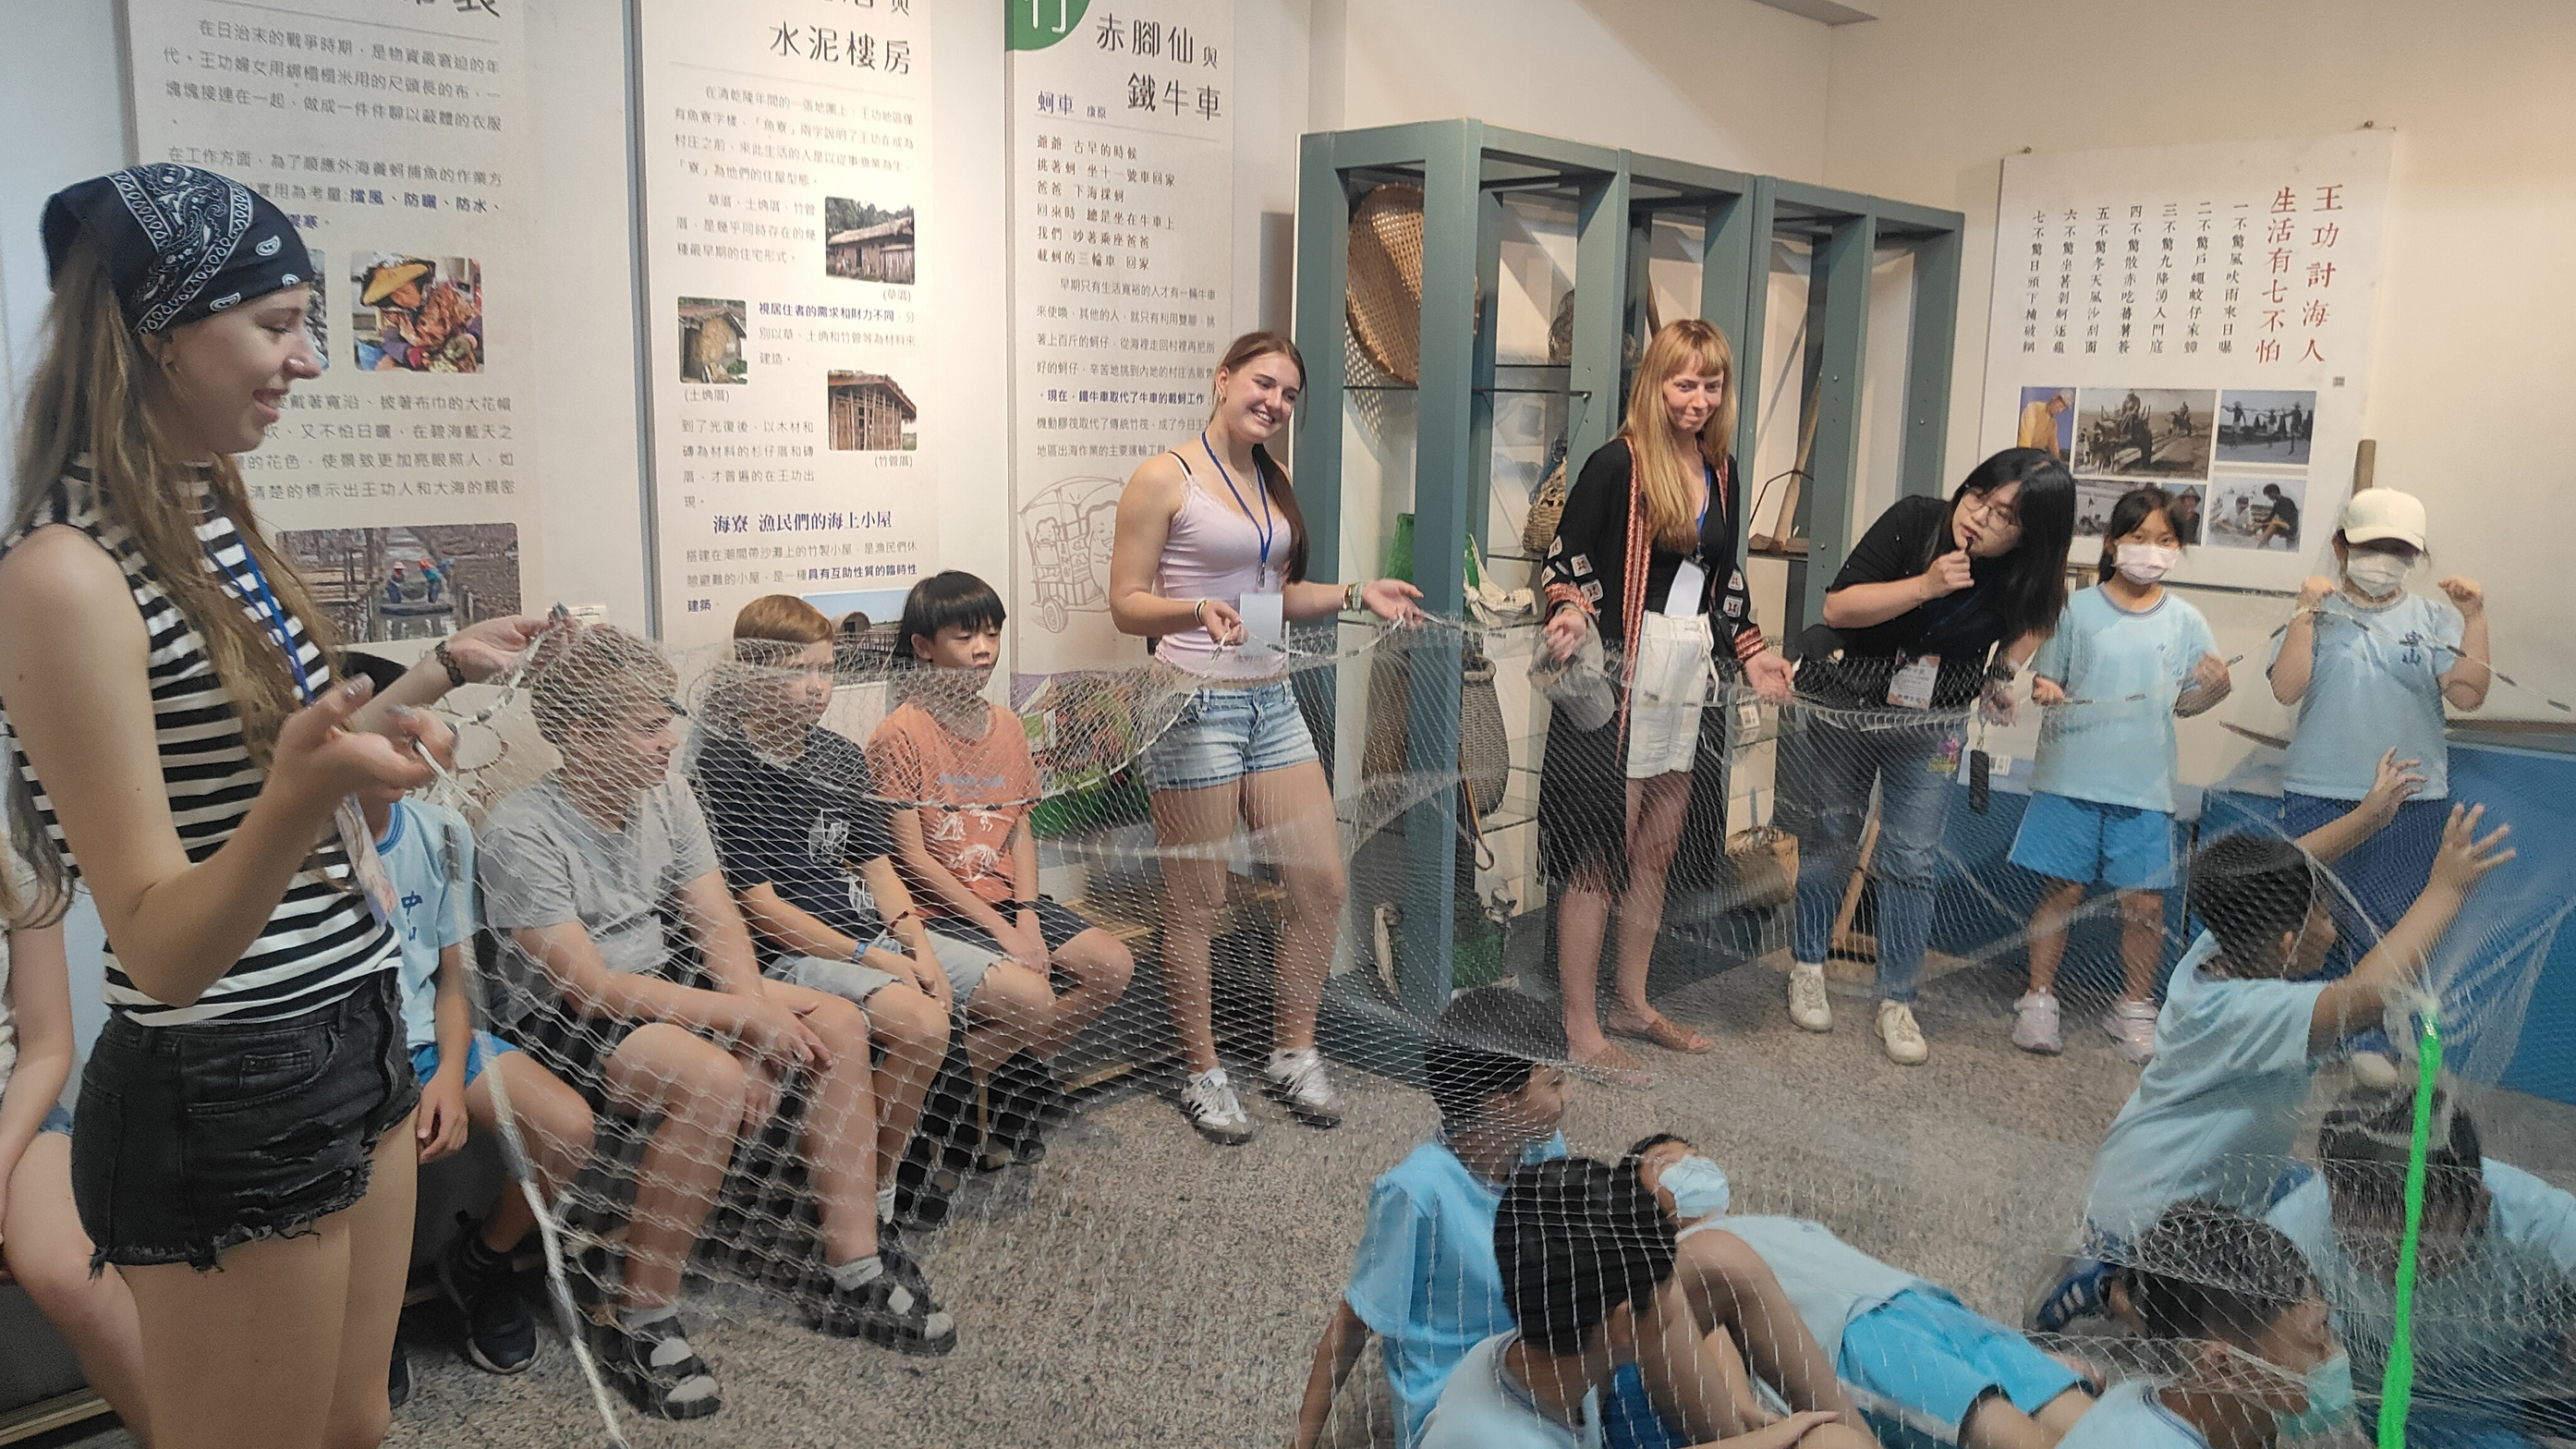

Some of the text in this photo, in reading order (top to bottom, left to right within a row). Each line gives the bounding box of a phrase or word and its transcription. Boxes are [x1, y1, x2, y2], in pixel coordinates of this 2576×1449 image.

[769, 20, 911, 75] 水泥樓房
[1037, 90, 1075, 116] 蚵車
[1126, 72, 1221, 121] 鐵牛車
[1037, 134, 1137, 162] 爺爺 古早的時候
[1037, 157, 1176, 187] 挑著蚵 坐十一號車回家
[1037, 180, 1124, 203] 爸爸 下海採蚵
[1037, 203, 1175, 231] 回來時 總是坐在牛車上
[1037, 225, 1063, 241] 我們
[1037, 249, 1149, 271] 載蚵的三輪車 回家
[2297, 184, 2344, 364] 王功討海人
[2255, 186, 2298, 364] 生活有七不怕
[712, 510, 893, 534] 海寮 漁民們的海上小屋
